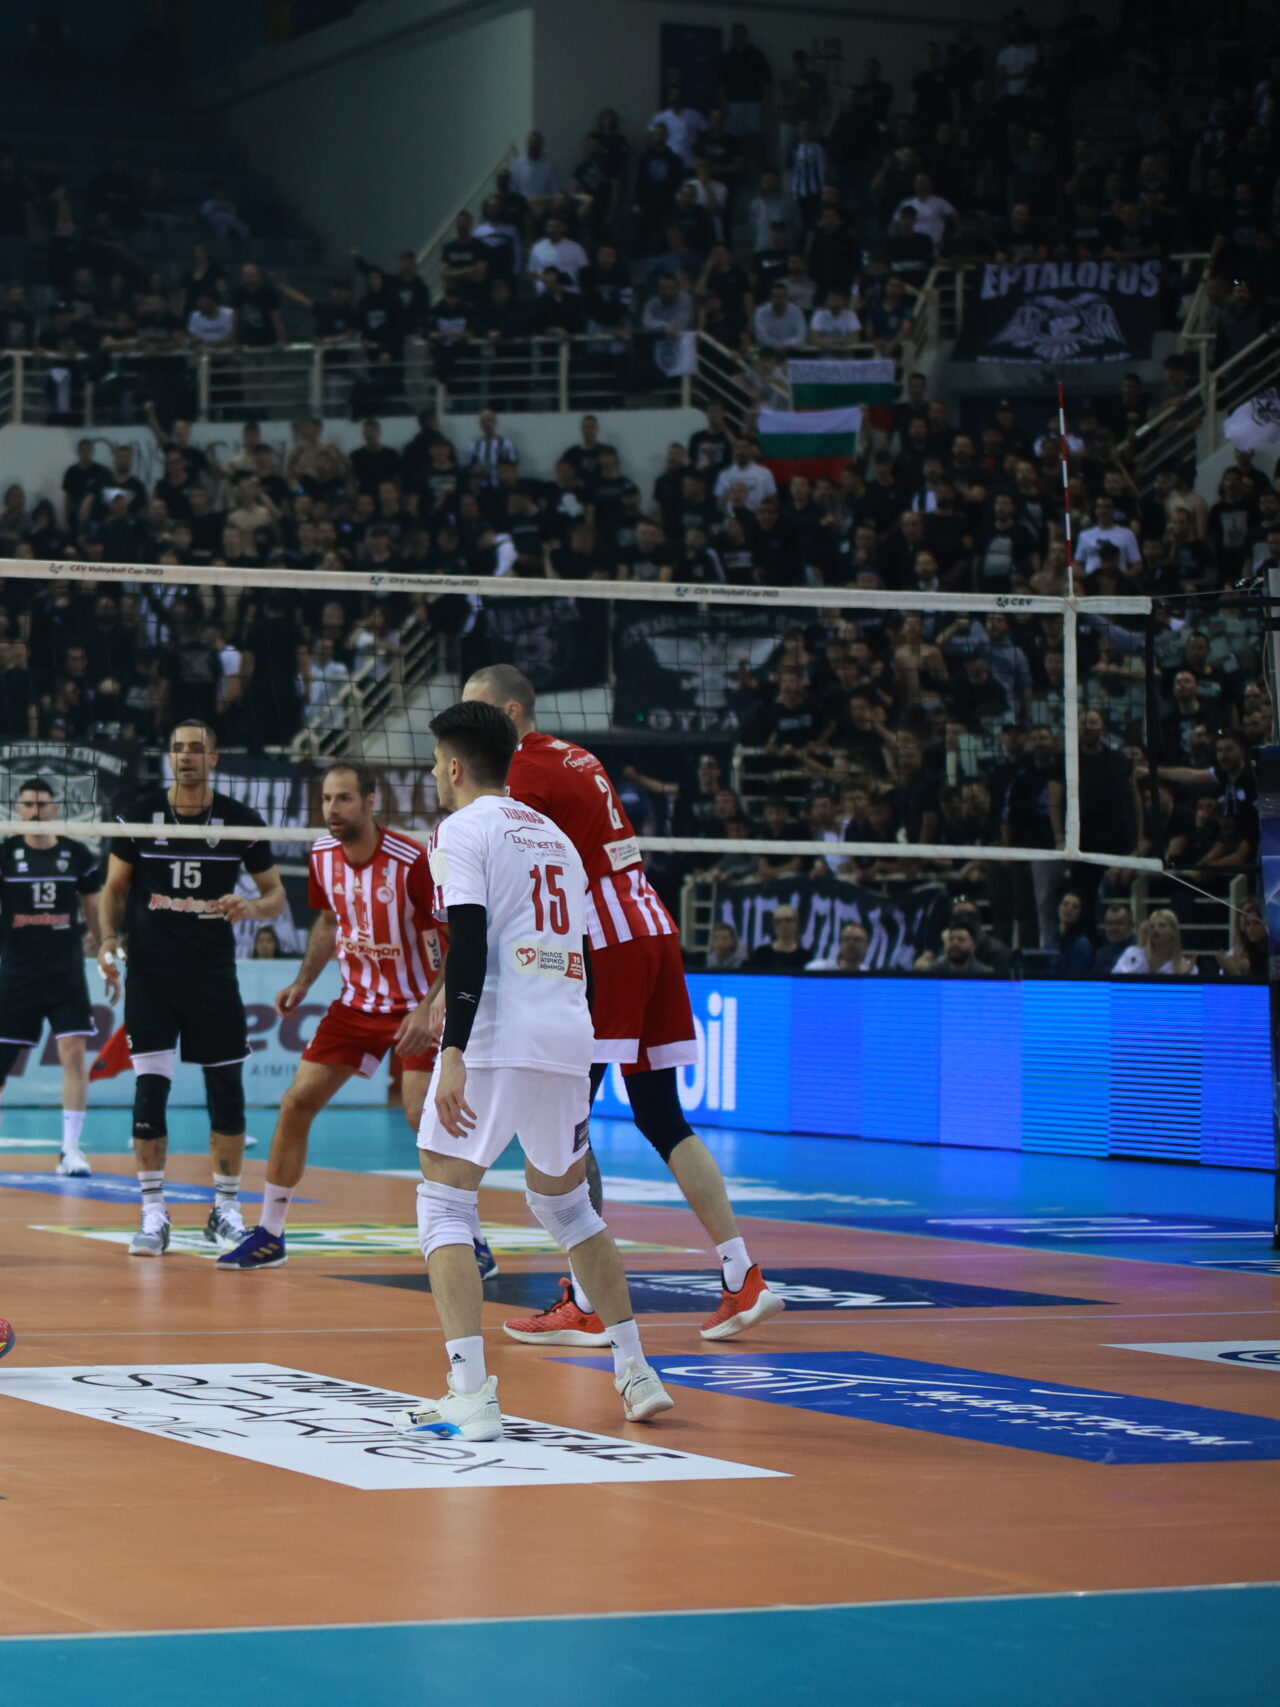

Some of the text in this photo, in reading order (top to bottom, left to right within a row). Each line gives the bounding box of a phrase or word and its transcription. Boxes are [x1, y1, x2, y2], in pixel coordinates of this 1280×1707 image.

[1010, 597, 1033, 607] CEV
[593, 774, 625, 830] 2
[31, 881, 57, 903] 13
[169, 861, 203, 890] 15
[529, 863, 570, 936] 15
[76, 1406, 250, 1439] HOME
[846, 1392, 1111, 1437] AIRLINES
[894, 1390, 1254, 1446] MARATHON
